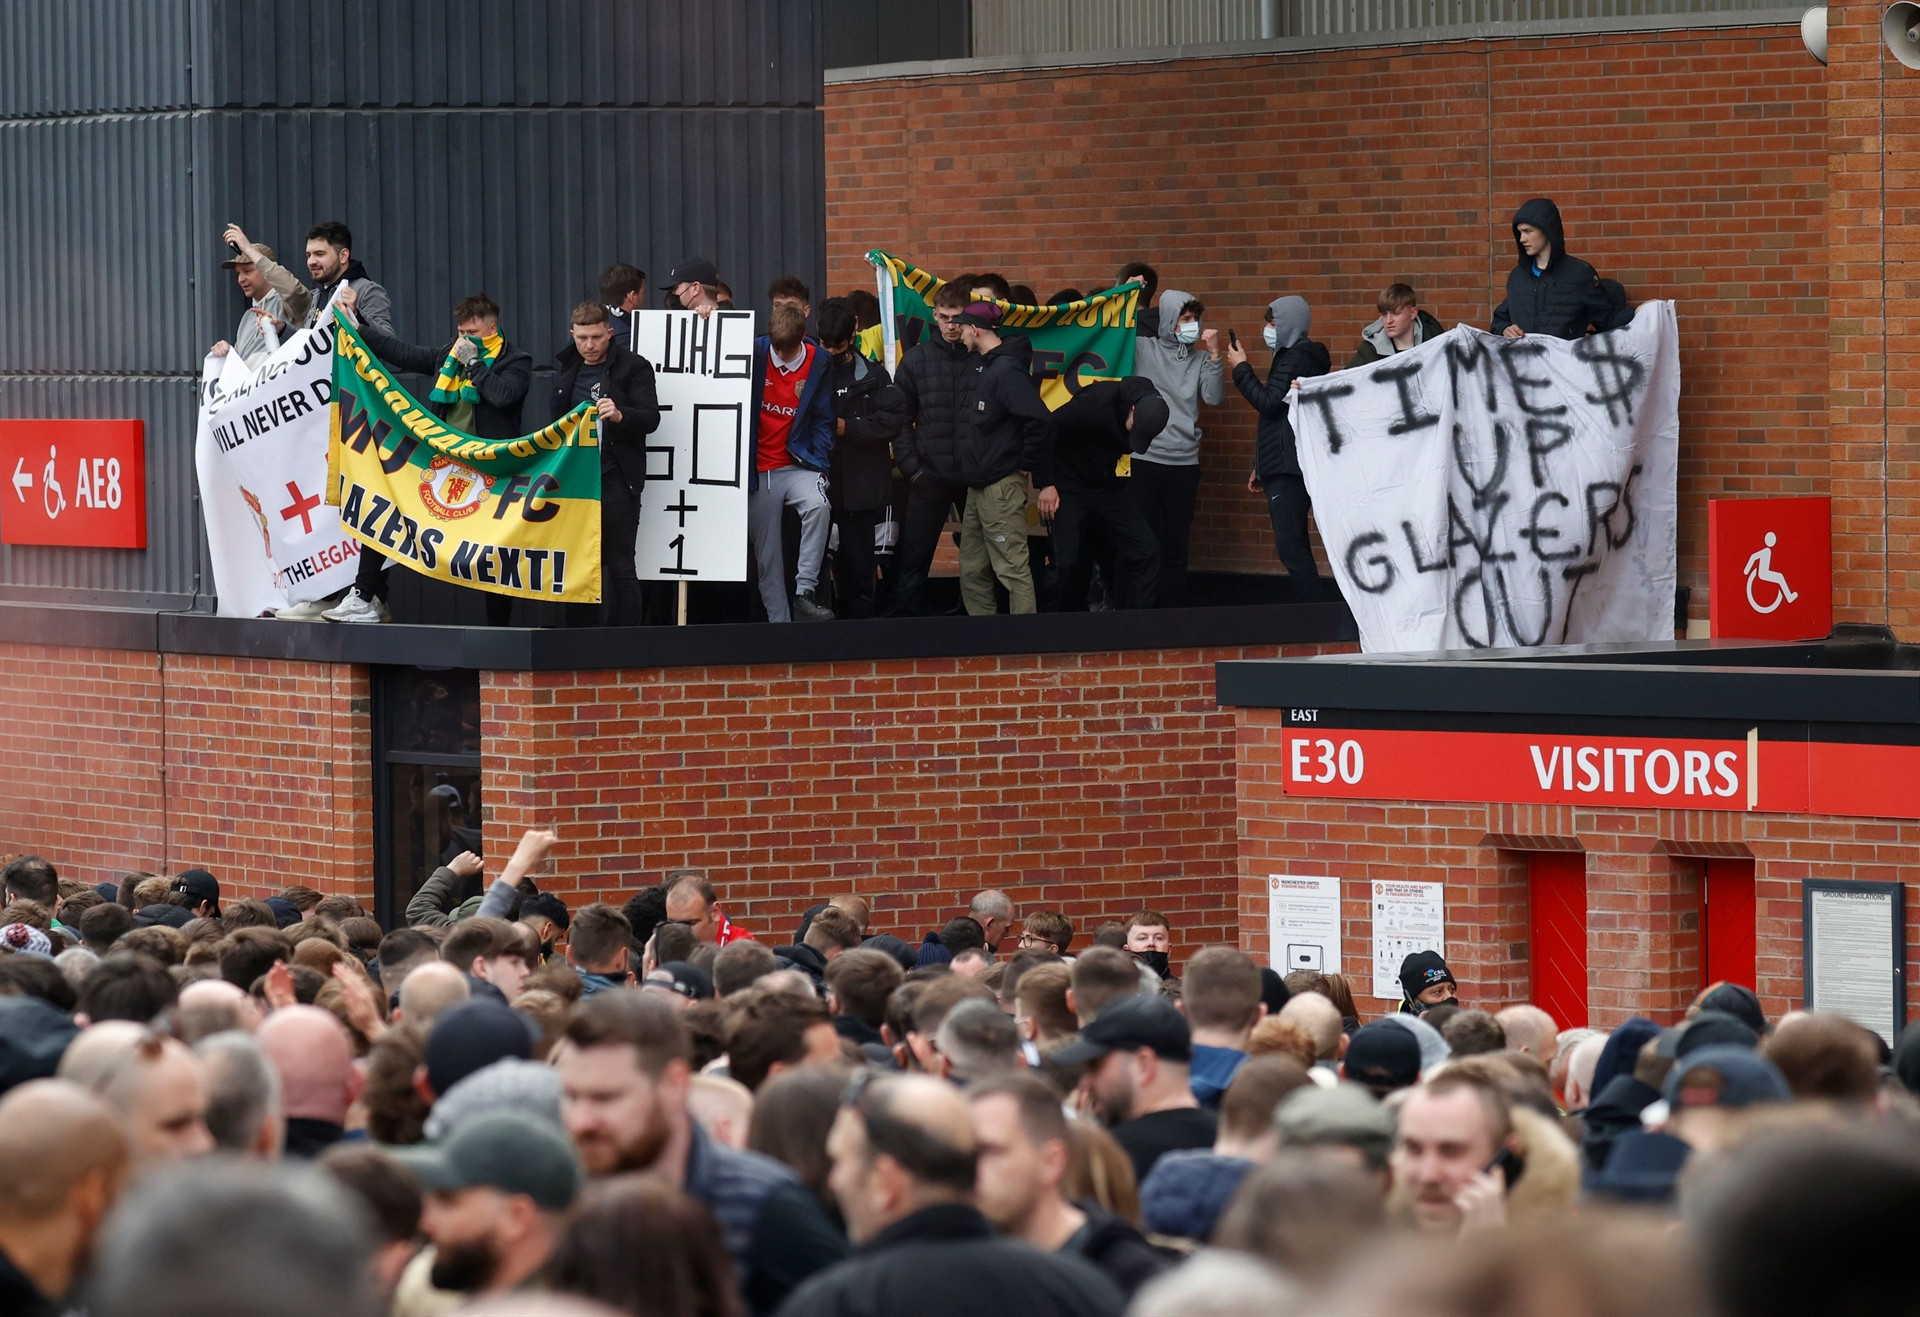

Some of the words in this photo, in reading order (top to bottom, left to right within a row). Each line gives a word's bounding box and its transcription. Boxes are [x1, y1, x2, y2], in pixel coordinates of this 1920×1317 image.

[1032, 349, 1108, 396] FC
[242, 390, 314, 440] NEVER
[339, 387, 420, 475] MU
[492, 473, 561, 523] FC
[1452, 416, 1572, 509] UP
[75, 457, 122, 510] AE8
[422, 489, 451, 517] FOOTBALL
[452, 506, 474, 518] CLUB
[450, 540, 567, 594] NEXT!
[659, 534, 698, 576] 1
[1453, 562, 1598, 648] OUT
[1290, 708, 1318, 722] EAST
[1290, 738, 1365, 785] E30
[1529, 744, 1739, 797] VISITORS
[1822, 891, 1846, 899] GROUND
[1847, 892, 1886, 901] REGULATIONS
